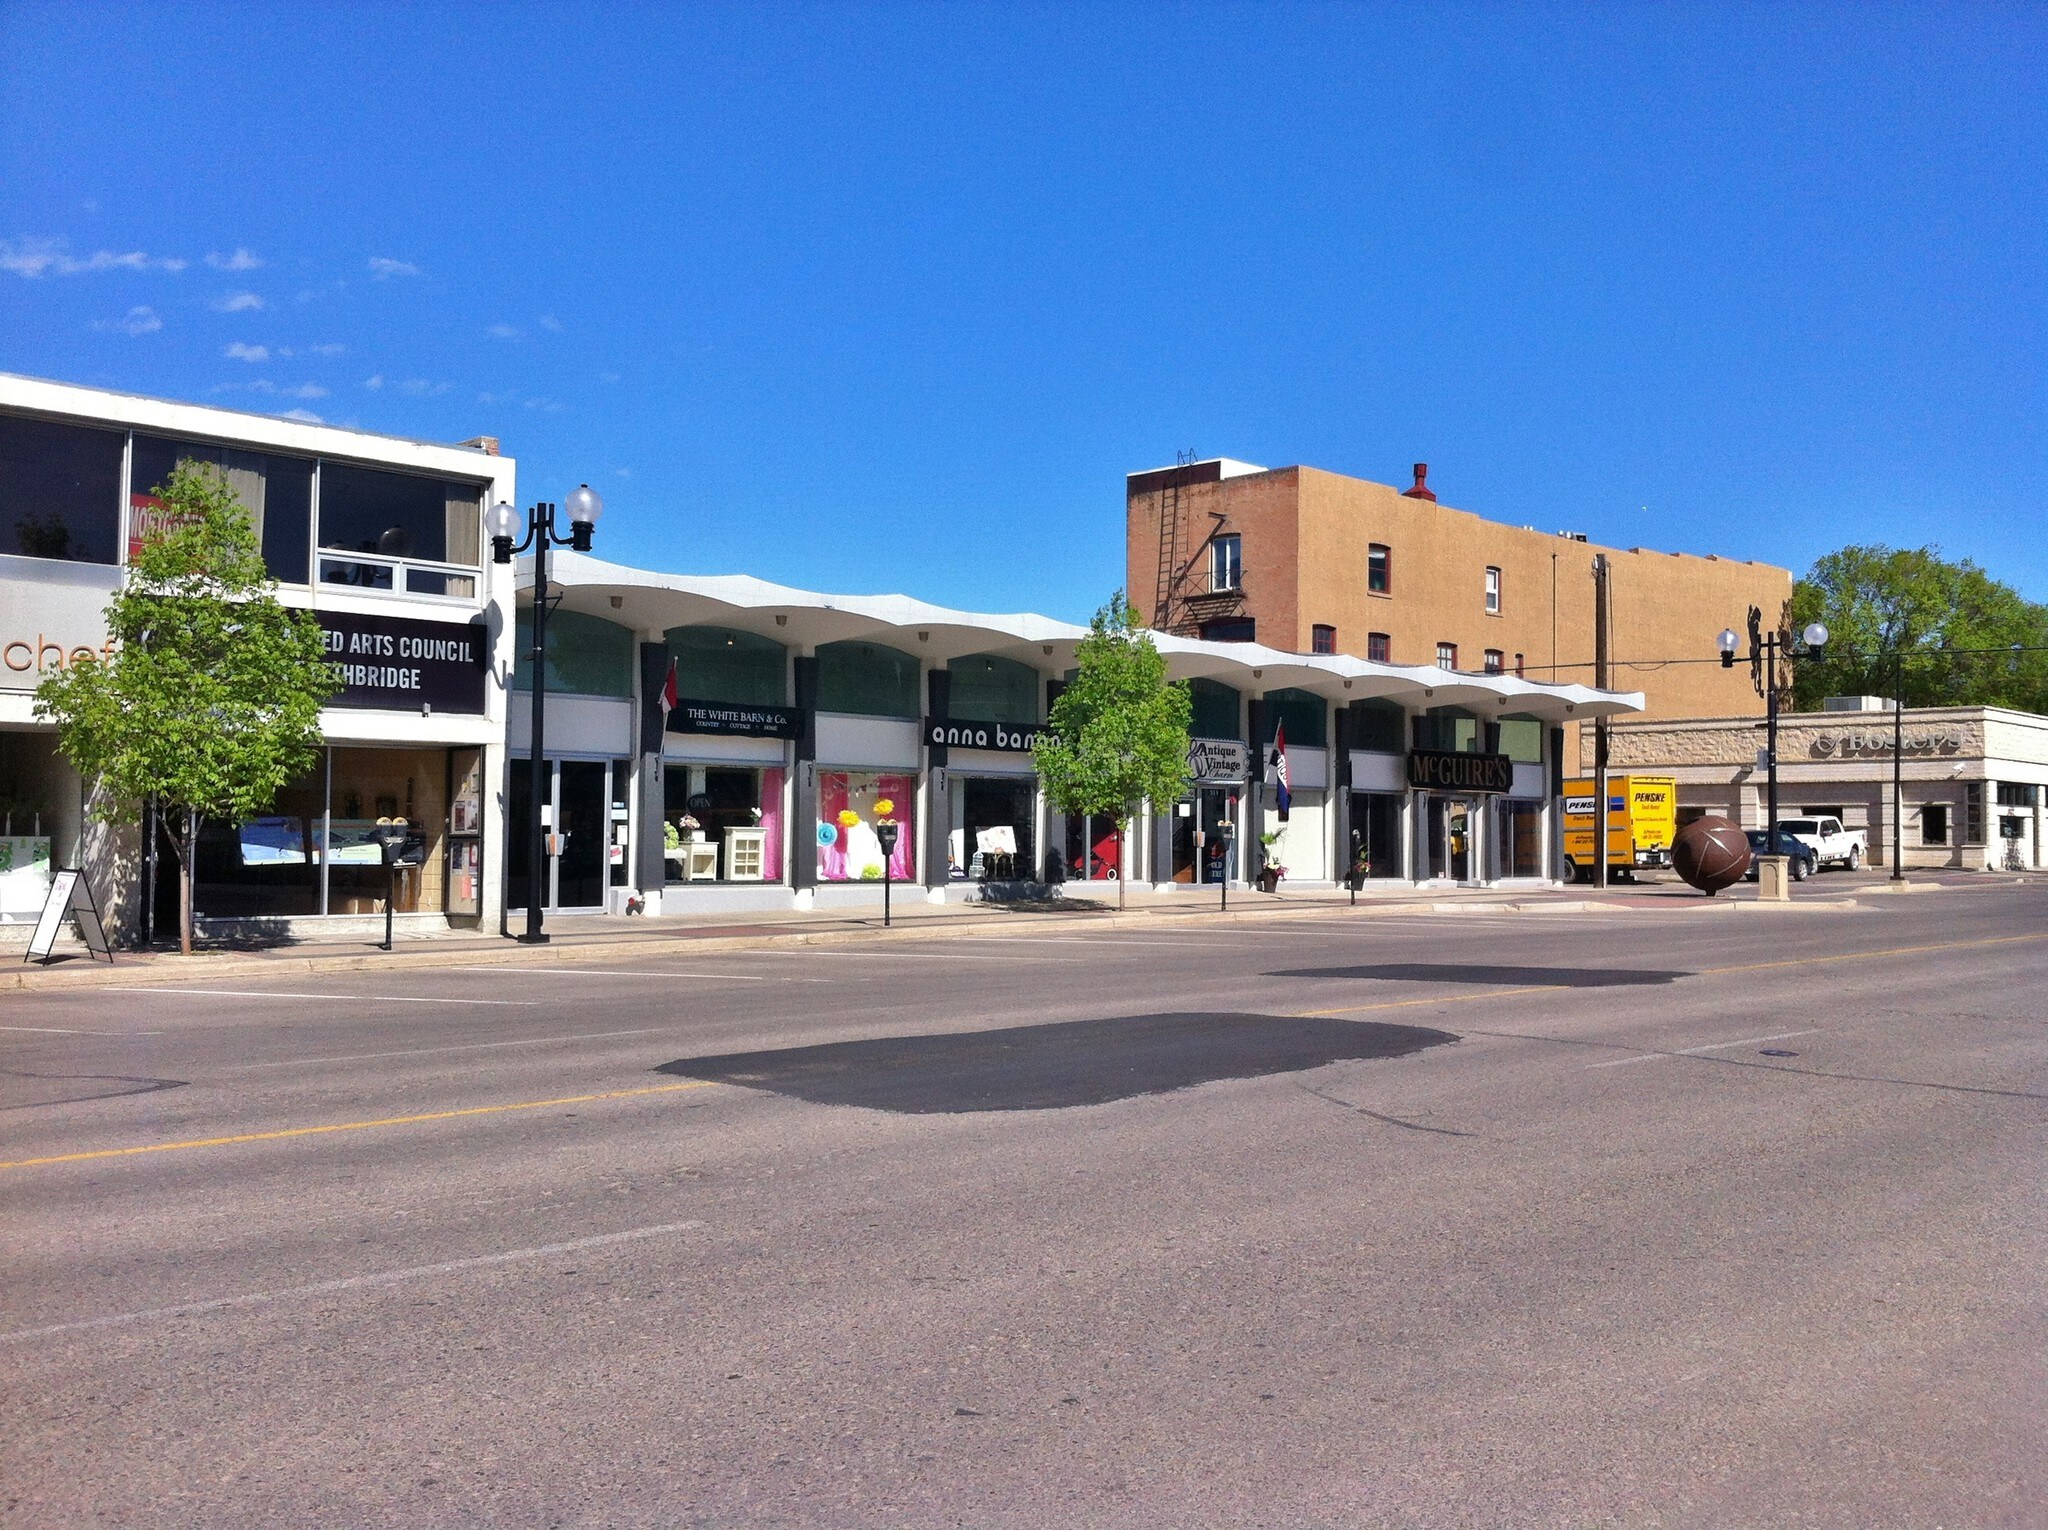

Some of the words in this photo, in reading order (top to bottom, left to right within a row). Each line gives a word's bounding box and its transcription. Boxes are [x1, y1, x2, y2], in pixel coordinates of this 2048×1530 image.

[4, 633, 116, 673] chef
[349, 632, 394, 657] ARTS
[400, 636, 474, 662] COUNCIL
[333, 662, 421, 690] HBRIDGE
[688, 708, 707, 719] THE
[708, 709, 739, 721] WHITE
[740, 711, 764, 723] BARN
[766, 713, 773, 723] &
[932, 726, 987, 746] anna
[1199, 742, 1237, 758] Antique
[1205, 757, 1241, 773] Vintage
[1568, 801, 1596, 809] PENS
[1634, 793, 1666, 802] PENSKE
